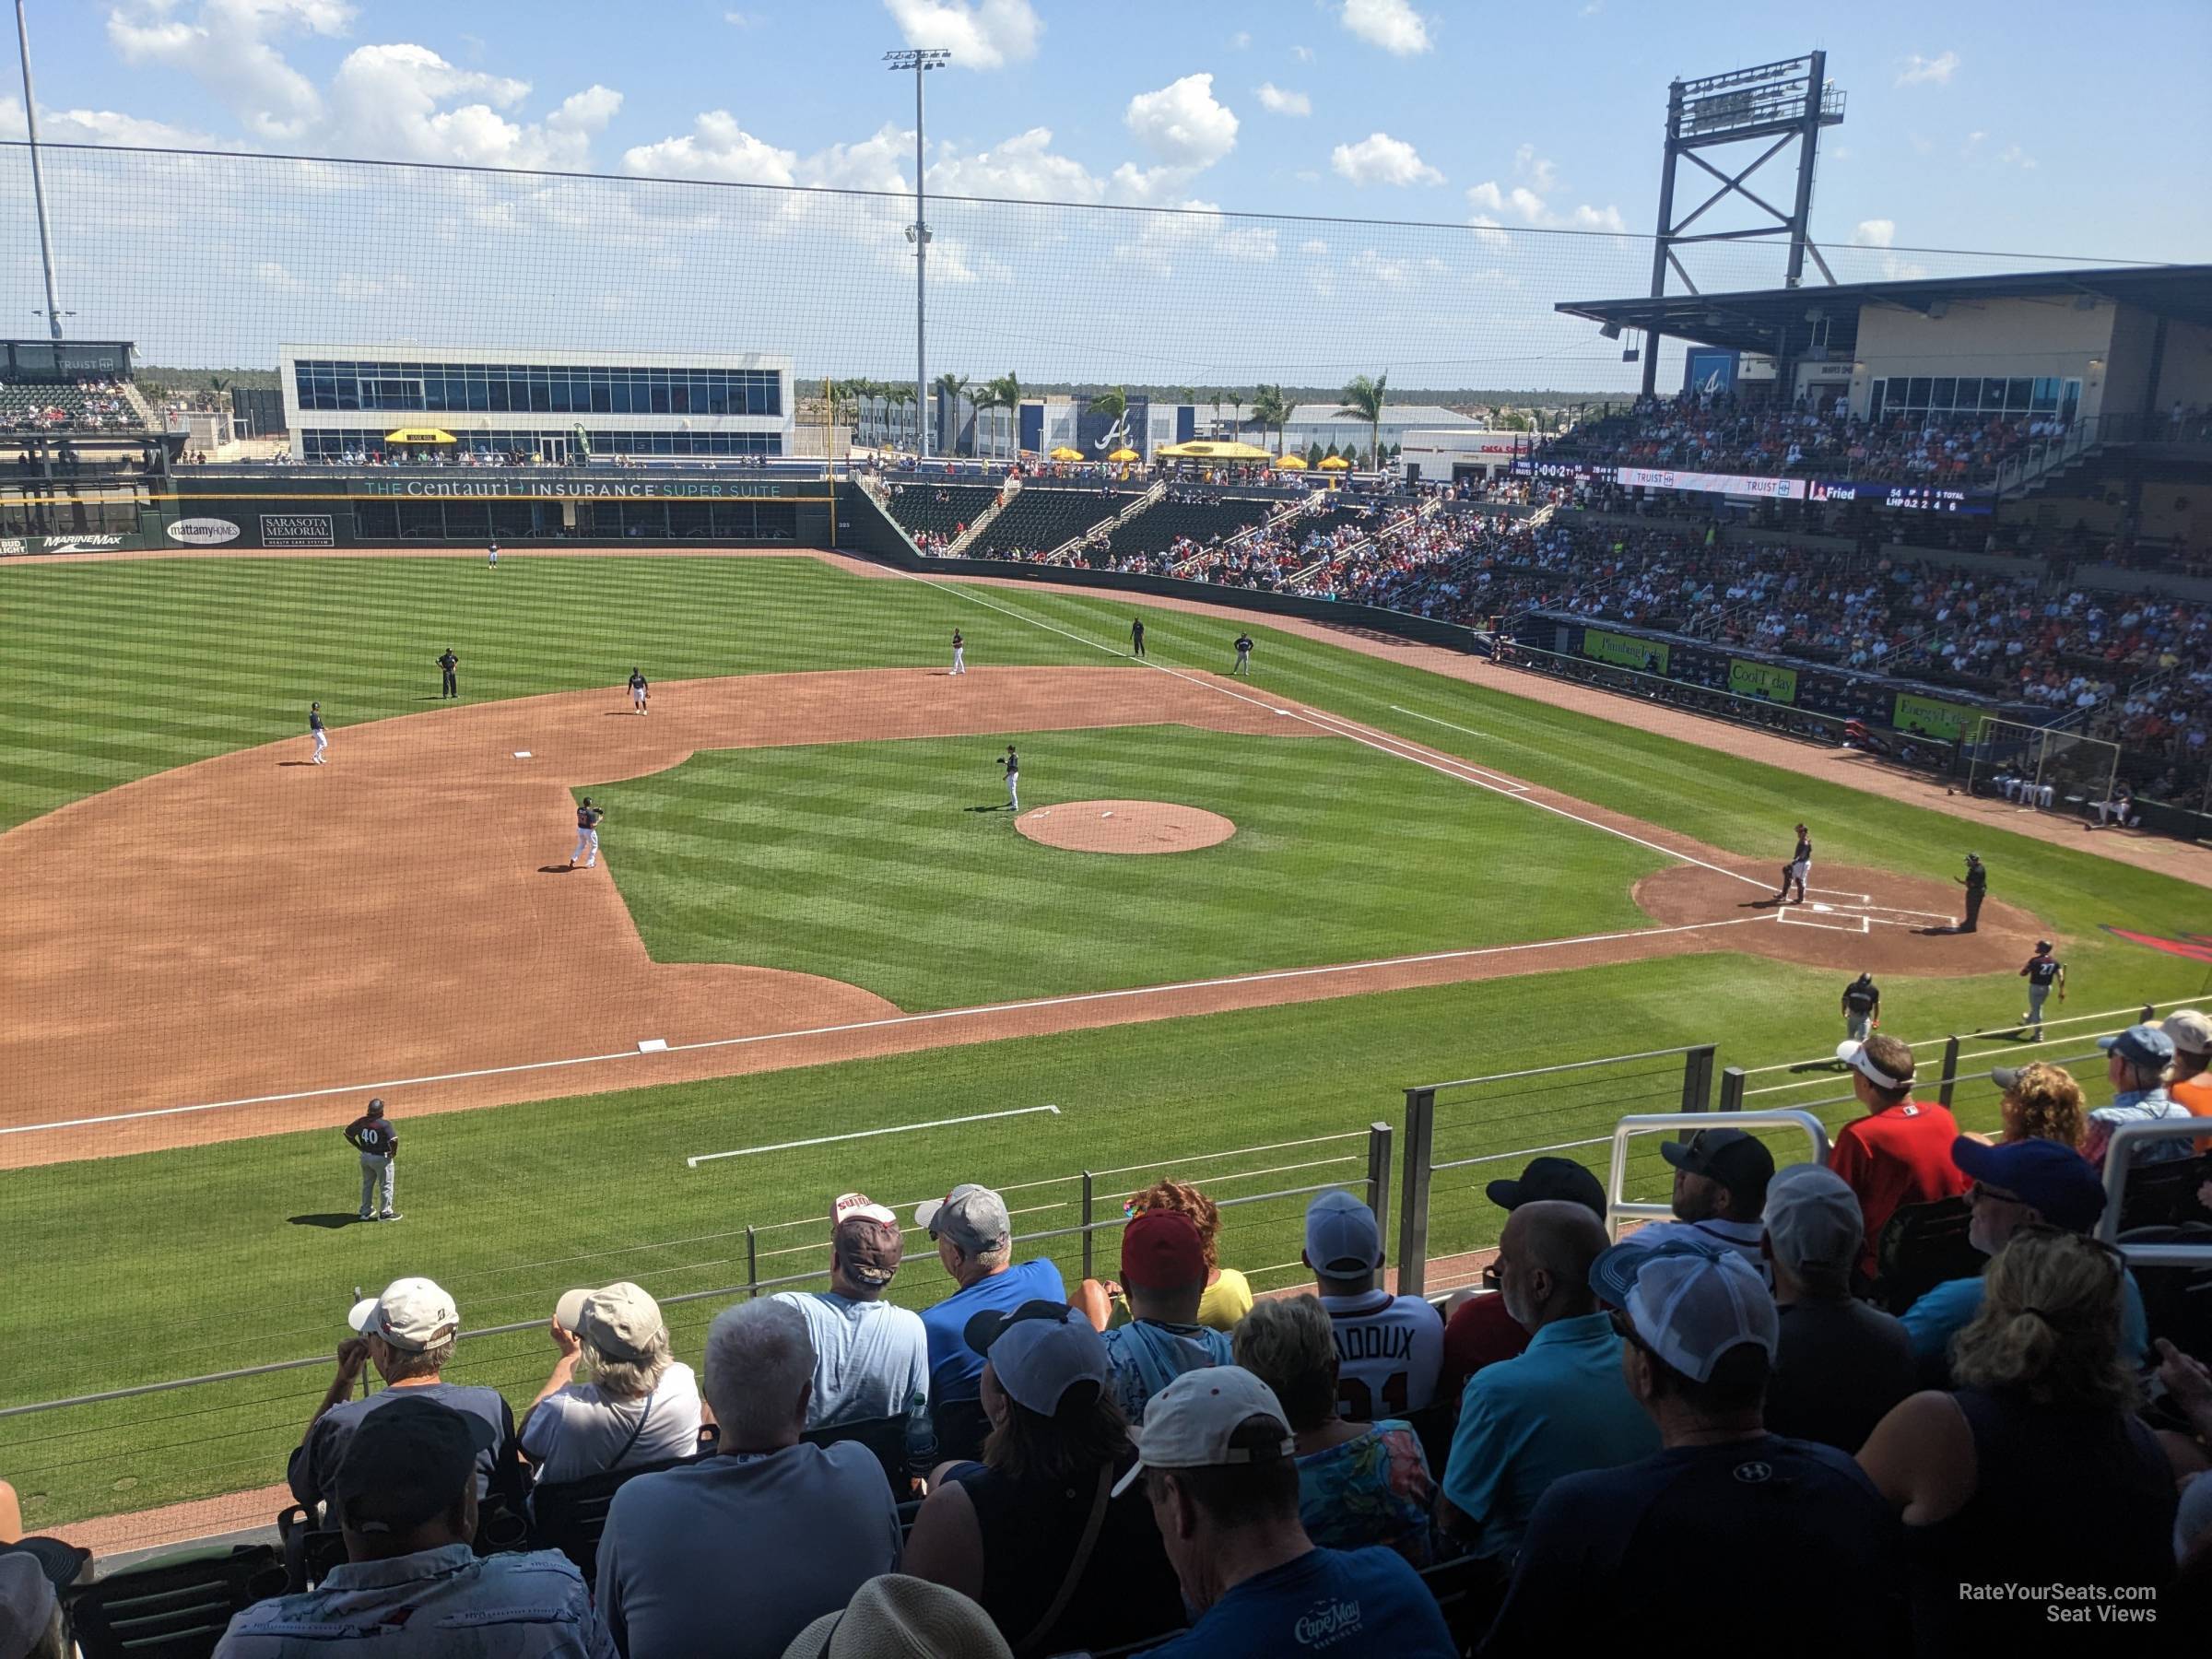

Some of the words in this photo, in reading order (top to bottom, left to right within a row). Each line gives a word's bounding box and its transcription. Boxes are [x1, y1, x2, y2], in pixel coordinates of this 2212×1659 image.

[57, 360, 97, 370] TRUIST
[1637, 473, 1664, 483] TRUIST
[364, 482, 403, 495] THE
[407, 478, 510, 496] Centauri
[532, 483, 655, 497] INSURANCE
[663, 485, 722, 498] SUPER
[730, 485, 782, 498] SUITE
[1747, 481, 1777, 492] TRUIST
[1827, 487, 1855, 500] Fried
[1890, 488, 1901, 498] 54
[1943, 491, 1965, 500] TOTAL
[1886, 498, 1904, 507] LHP
[1904, 499, 1918, 508] 0.2
[1921, 500, 1928, 509] 2
[265, 518, 327, 527] SARASOTA
[266, 526, 329, 536] MEMORIAL
[1732, 665, 1793, 692] CoolTday
[2040, 962, 2054, 975] 27
[361, 1128, 378, 1144] 40
[1334, 1325, 1416, 1361] ADDUX
[1294, 1616, 1332, 1644] Cape
[1319, 1600, 1361, 1632] May
